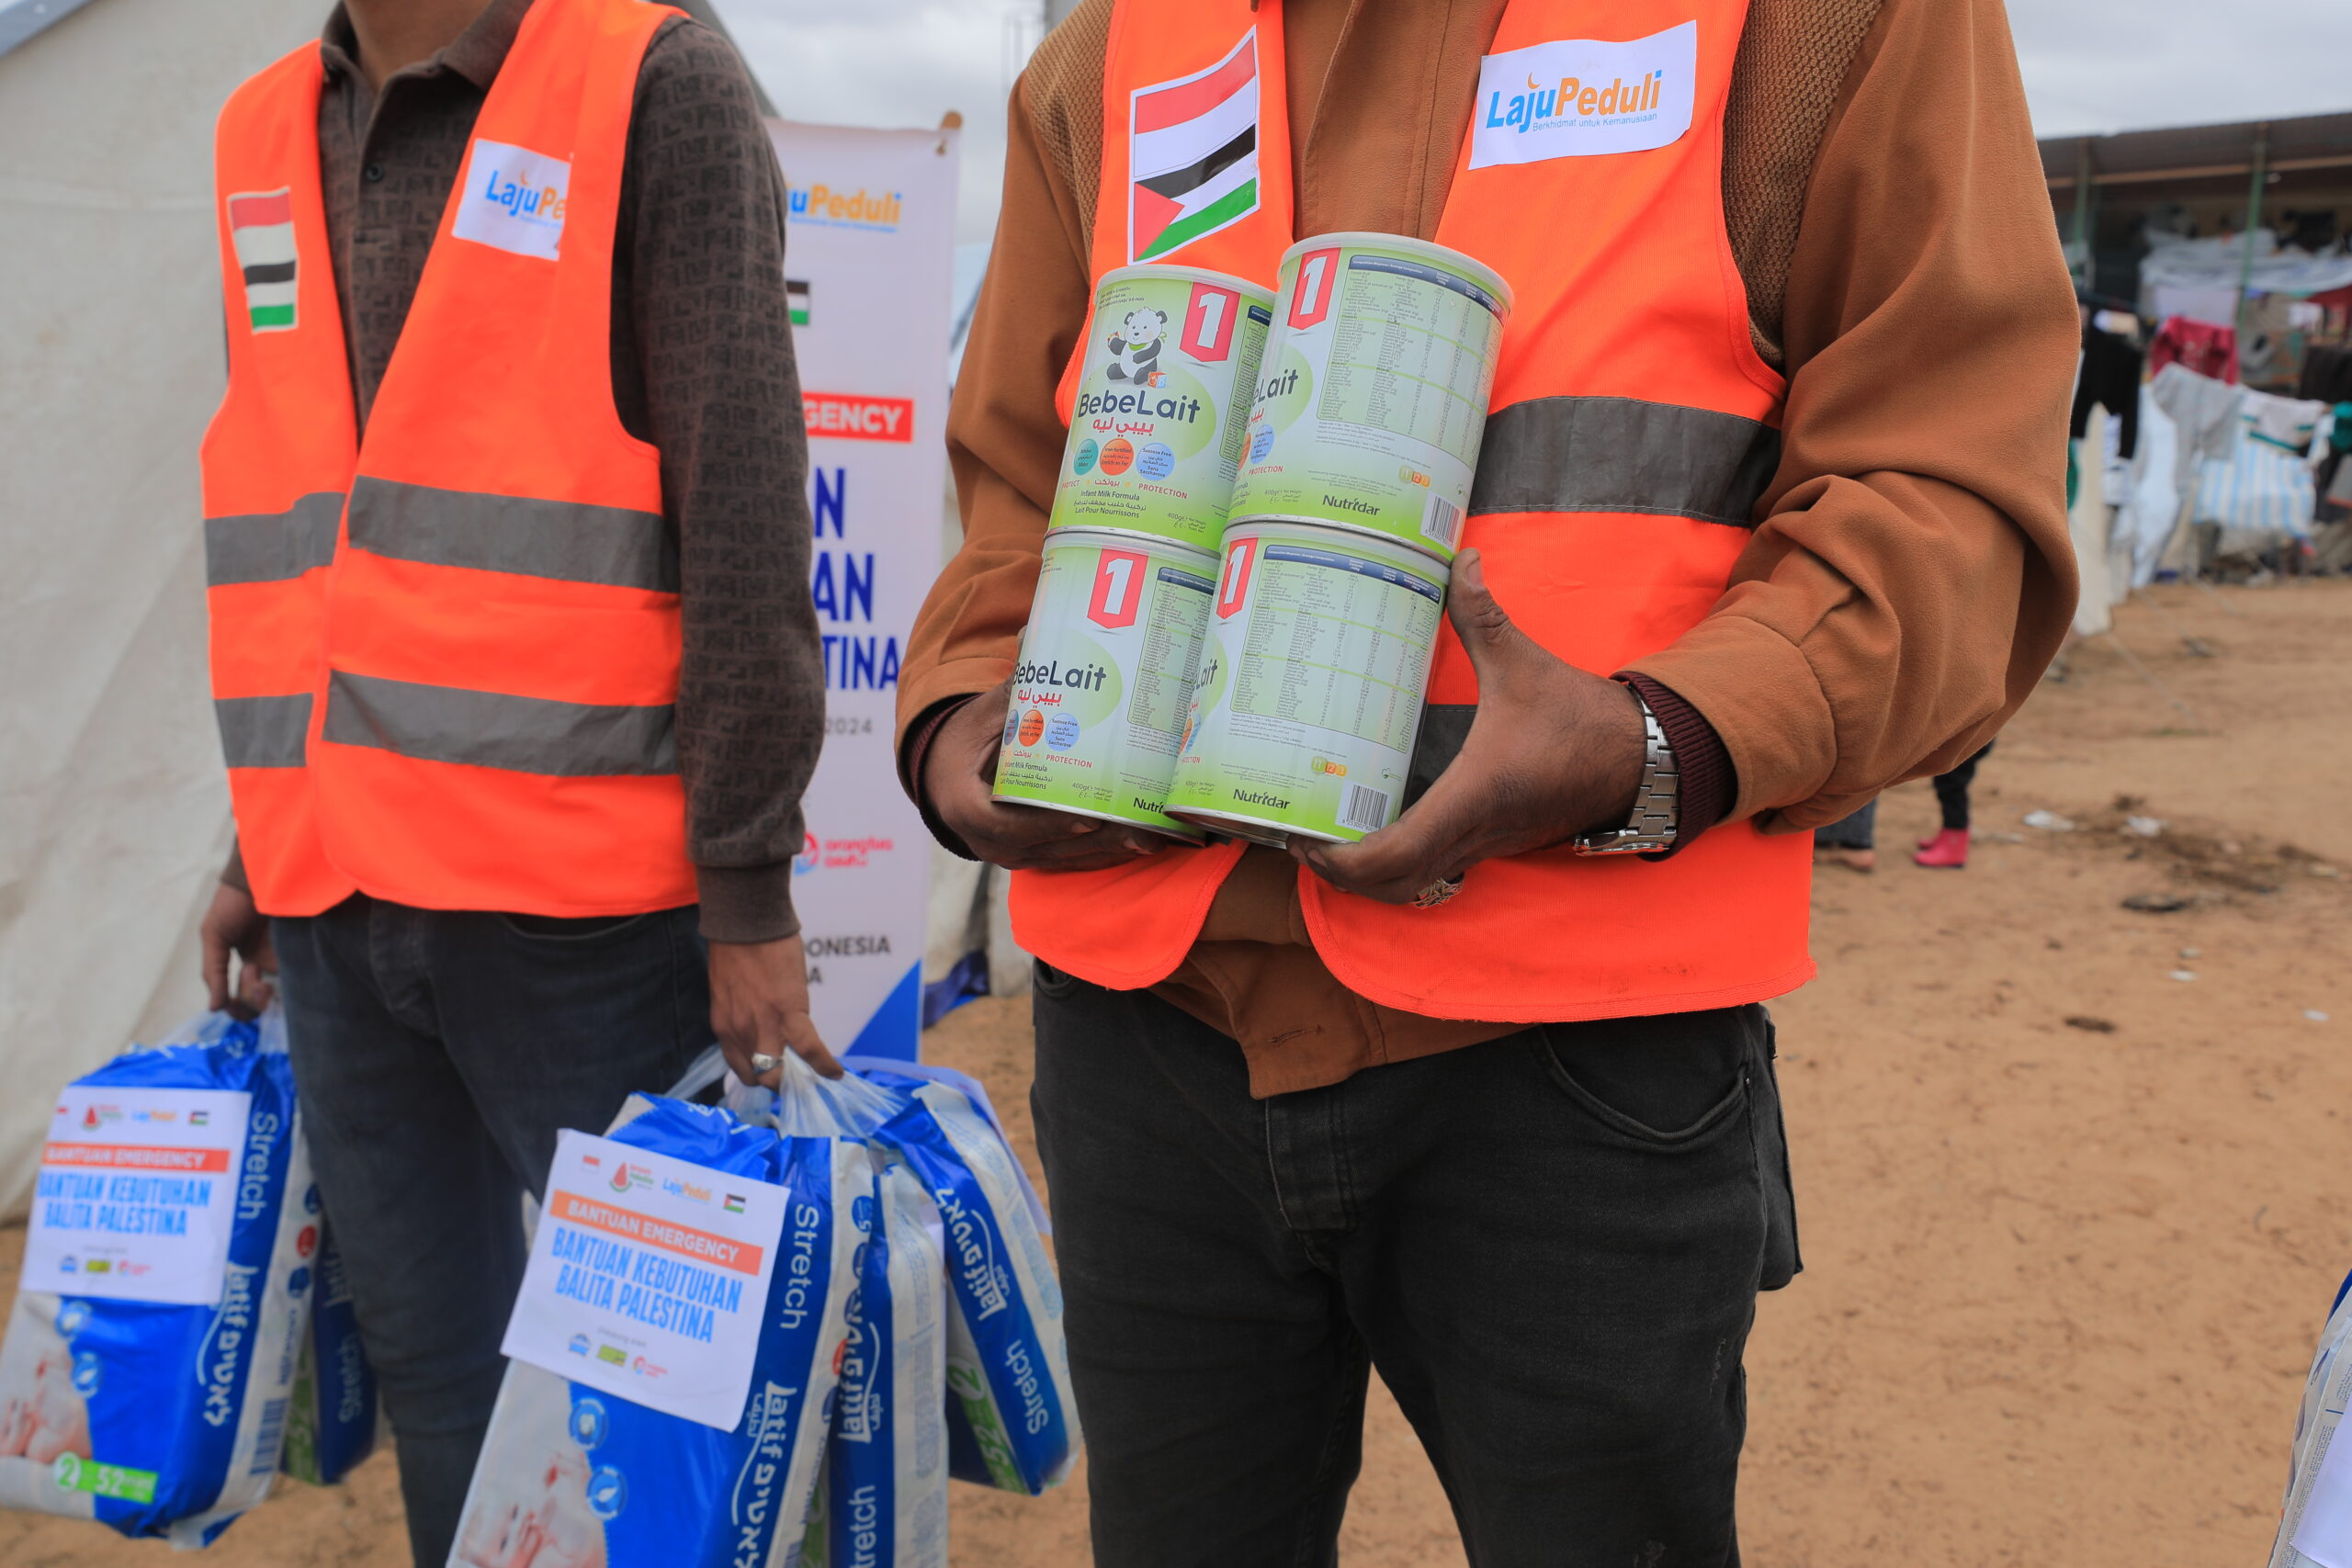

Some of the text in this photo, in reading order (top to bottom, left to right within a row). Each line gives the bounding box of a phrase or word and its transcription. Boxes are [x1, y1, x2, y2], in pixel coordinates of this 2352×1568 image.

[1486, 70, 1663, 134] LajuPeduli
[1532, 113, 1658, 132] Berkhidmat untuk Kemanusiaan
[485, 169, 565, 220] LajuPe
[788, 183, 903, 225] uPeduli
[1299, 256, 1328, 316] 1
[1198, 292, 1227, 349] 1
[1253, 369, 1299, 407] eLait
[803, 399, 904, 434] GENCY
[1078, 389, 1201, 423] BebeLait
[1092, 417, 1155, 438] بيبي ليه
[1142, 447, 1160, 457] Sucrose
[1139, 468, 1166, 478] Saccharose
[1249, 466, 1283, 476] PROTECTION
[1080, 490, 1097, 498] Infant
[1112, 491, 1140, 501] Formula
[1138, 483, 1188, 500] PROTECTION
[1322, 493, 1381, 516] Nutridar
[1075, 506, 1085, 514] Lait
[1100, 507, 1140, 519] Nourrissons
[813, 550, 875, 625] AN
[1105, 558, 1135, 615] 1
[1224, 545, 1248, 604] 1
[820, 635, 900, 691] TINA
[1032, 692, 1062, 709] بيبي
[1048, 739, 1071, 748] Saccharose
[1025, 762, 1048, 773] Formula
[1046, 753, 1092, 769] PROTECTION
[1015, 778, 1047, 790] Nourrissons
[1233, 788, 1290, 810] Nutridar
[1133, 797, 1164, 814] Nutri
[807, 935, 892, 957] ONESIA
[115, 1149, 207, 1169] EMERGENCY
[238, 1111, 278, 1220] Stretch
[107, 1175, 212, 1208] KEBUTUHAN
[96, 1203, 188, 1236] PALESTINA
[567, 1200, 740, 1264] BANTUAN EMERGENCY
[551, 1227, 743, 1314] BANTUAN KEBUTUHAN
[779, 1202, 820, 1329] Stretch
[555, 1263, 716, 1344] BALITA PALESTINA
[1003, 1339, 1049, 1436] Stretch
[58, 1457, 76, 1488] 2
[95, 1464, 126, 1497] 52
[848, 1484, 877, 1568] tretch
